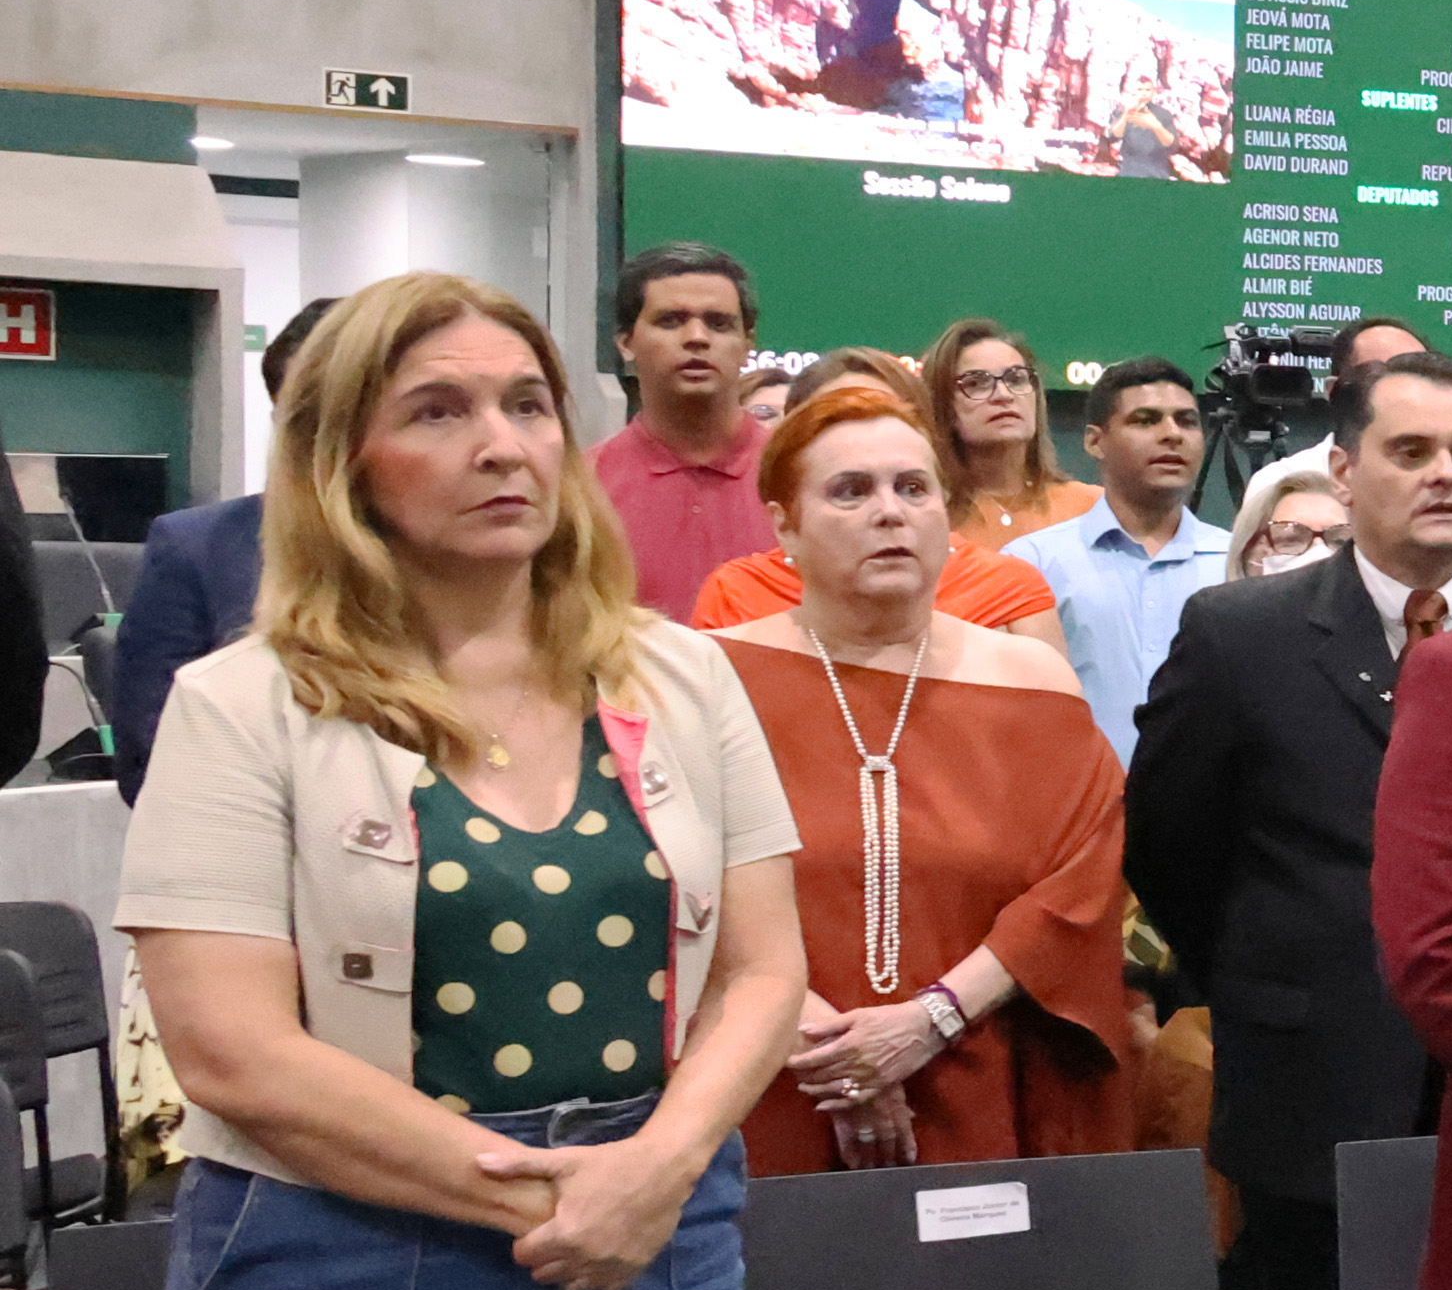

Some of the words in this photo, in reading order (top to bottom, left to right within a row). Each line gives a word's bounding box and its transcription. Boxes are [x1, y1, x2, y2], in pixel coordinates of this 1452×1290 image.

[1246, 7, 1287, 27] JEOVÁ
[1291, 12, 1330, 30] MOTA
[1246, 33, 1290, 51] FELIPE
[1294, 37, 1333, 55] MOTA
[1245, 55, 1280, 75] JOÃO
[1283, 60, 1324, 78] JAIME
[1362, 90, 1438, 111] SUPLENTES
[1245, 105, 1291, 123] LUANA
[1295, 105, 1335, 126] RÉGIA
[1245, 130, 1291, 148] EMILIA
[1295, 133, 1347, 151] PESSOA
[1244, 154, 1286, 171] DAVID
[1291, 156, 1348, 175] DURAND
[1358, 186, 1439, 206] DEPUTADOS
[1243, 203, 1299, 221] ACRISIO
[1303, 206, 1338, 223] SENA
[1243, 228, 1300, 246] AGENOR
[1304, 231, 1339, 248] NETO
[1243, 253, 1301, 270] ALCIDES
[1304, 255, 1383, 274] FERNANDES
[1243, 277, 1286, 294] ALMIR
[1290, 276, 1312, 295] BIÉ
[1243, 302, 1305, 319] ALYSSON
[1309, 304, 1361, 321] AGUIAR
[0, 303, 36, 344] H
